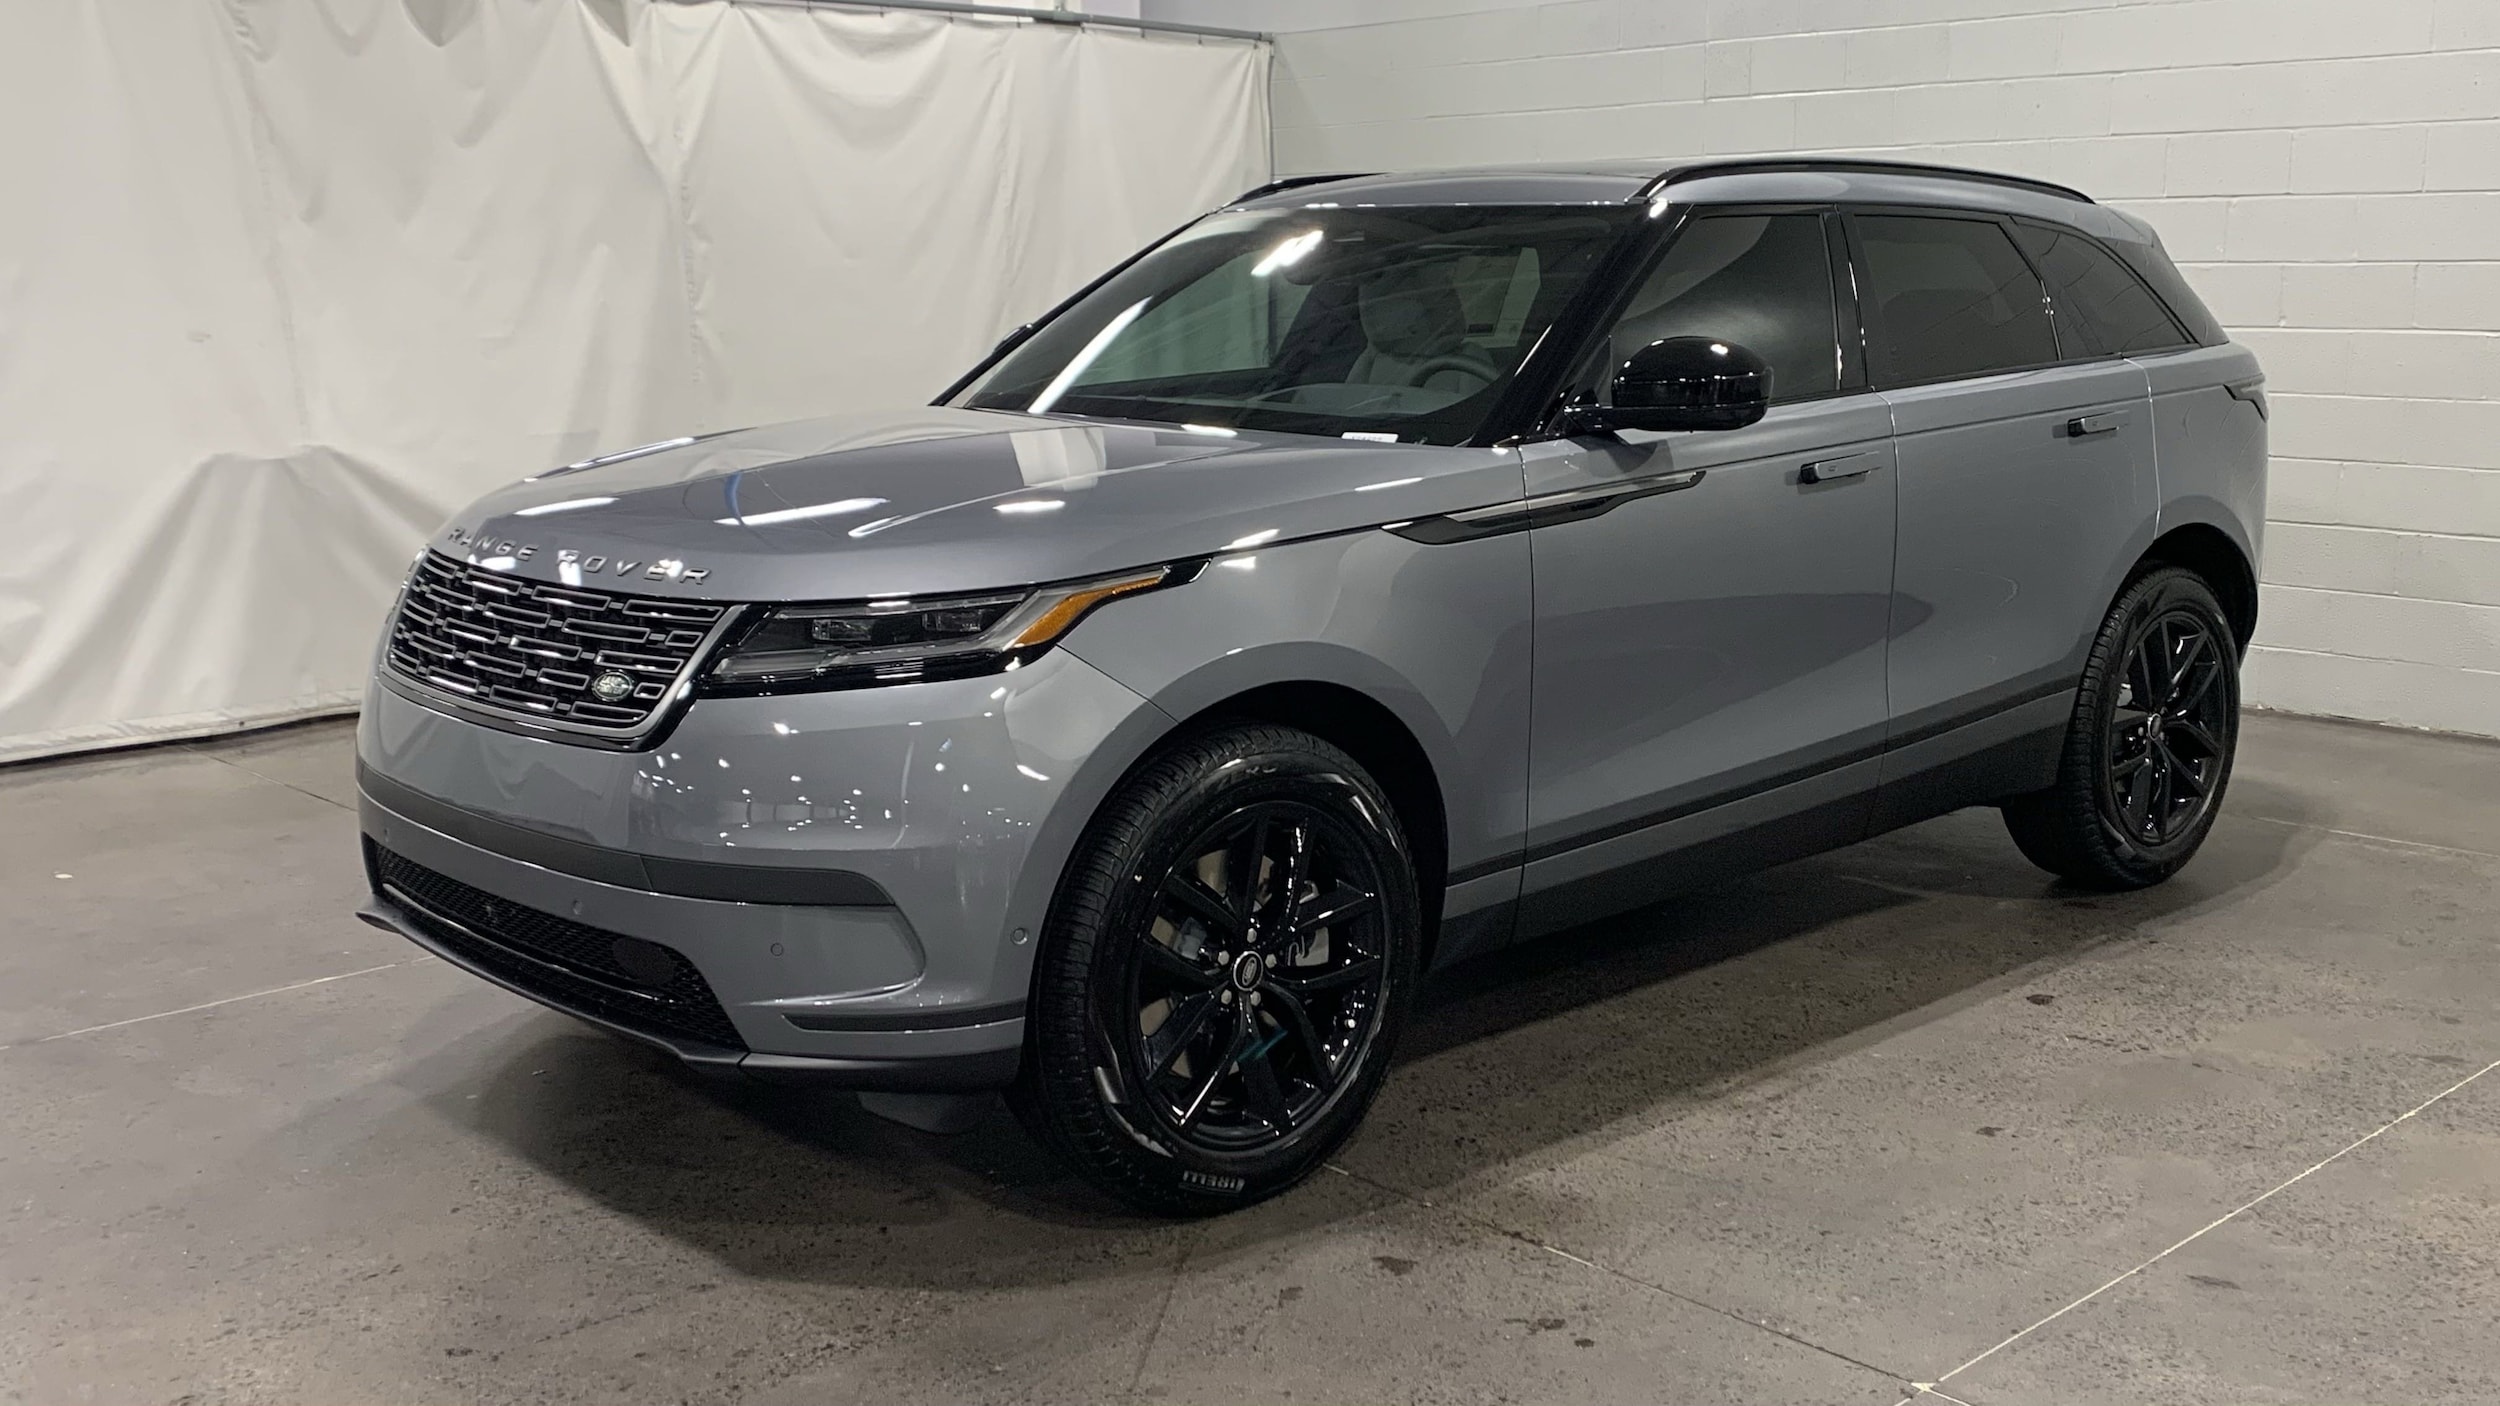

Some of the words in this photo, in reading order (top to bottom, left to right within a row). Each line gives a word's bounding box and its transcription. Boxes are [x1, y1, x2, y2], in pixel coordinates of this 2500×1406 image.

[447, 527, 540, 562] RANGE
[556, 548, 712, 586] ROVER
[1179, 1170, 1246, 1194] PIRELLI
